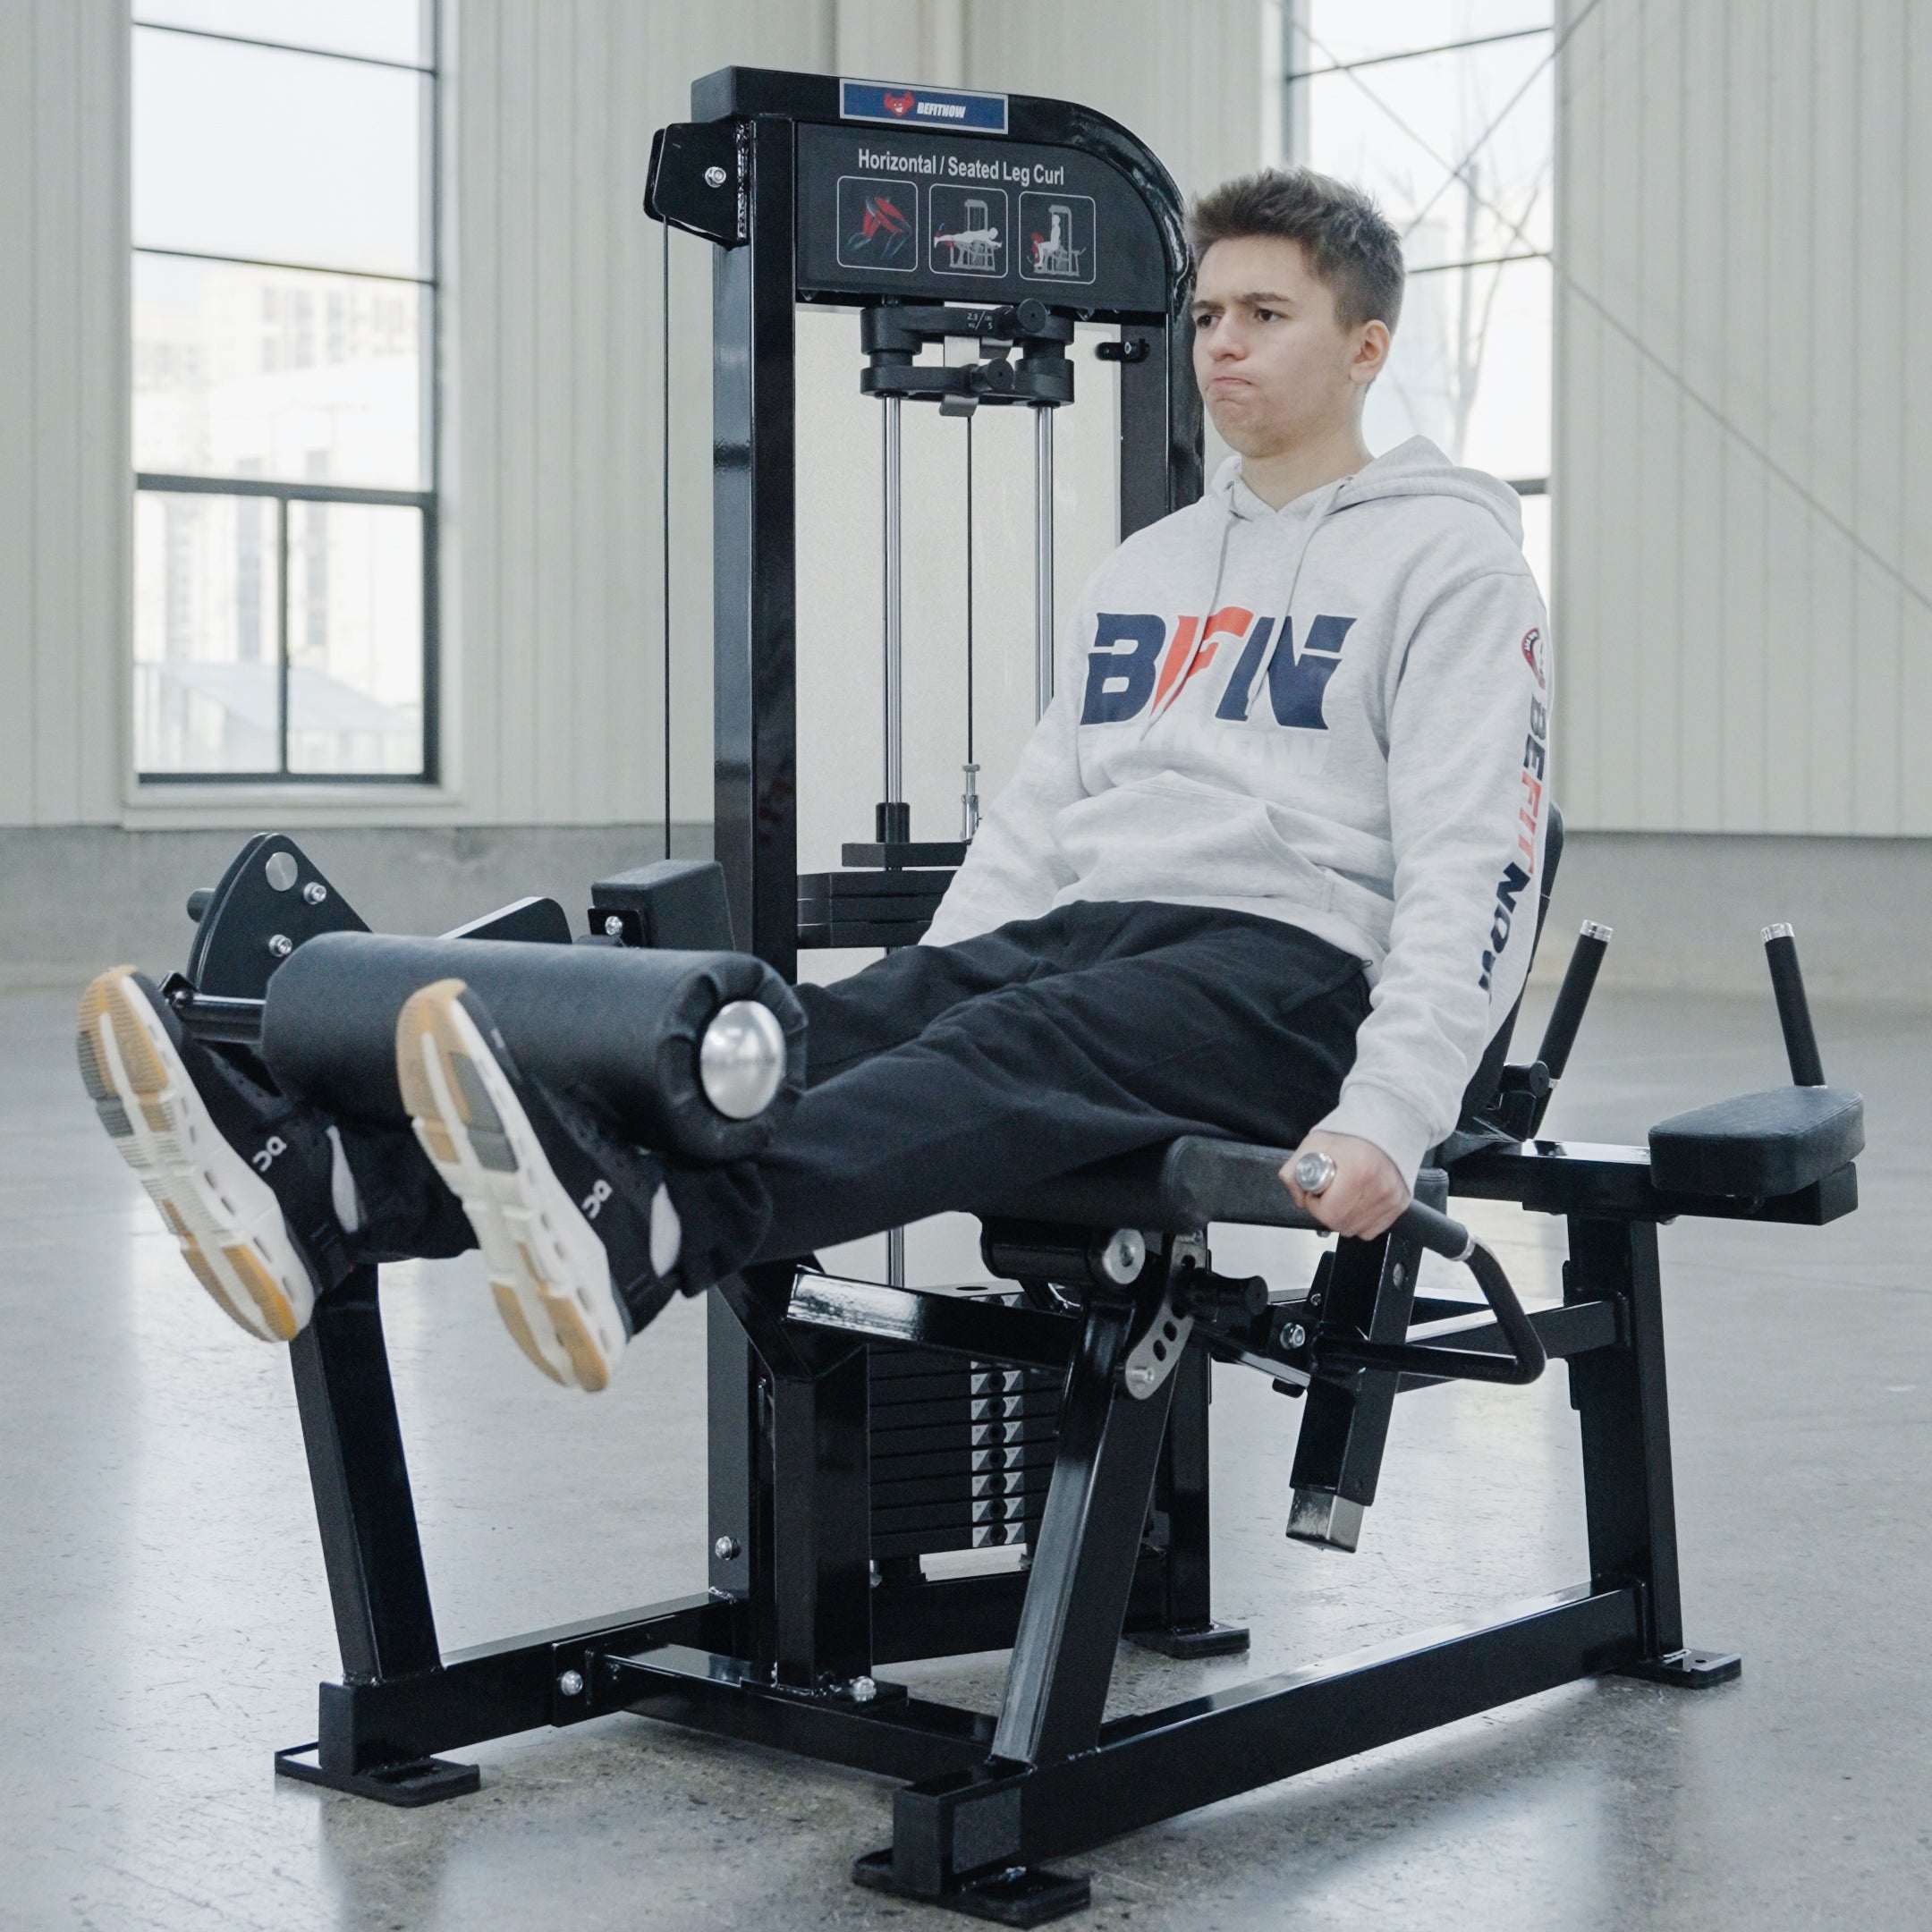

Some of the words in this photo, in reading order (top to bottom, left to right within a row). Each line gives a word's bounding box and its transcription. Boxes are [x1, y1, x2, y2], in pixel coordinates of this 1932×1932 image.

[917, 102, 966, 118] BEFITNOW
[858, 148, 936, 174] Horizontal
[948, 156, 999, 179] Seated
[1003, 161, 1030, 187] Leg
[1033, 164, 1064, 185] Curl
[1080, 606, 1358, 730] BFN
